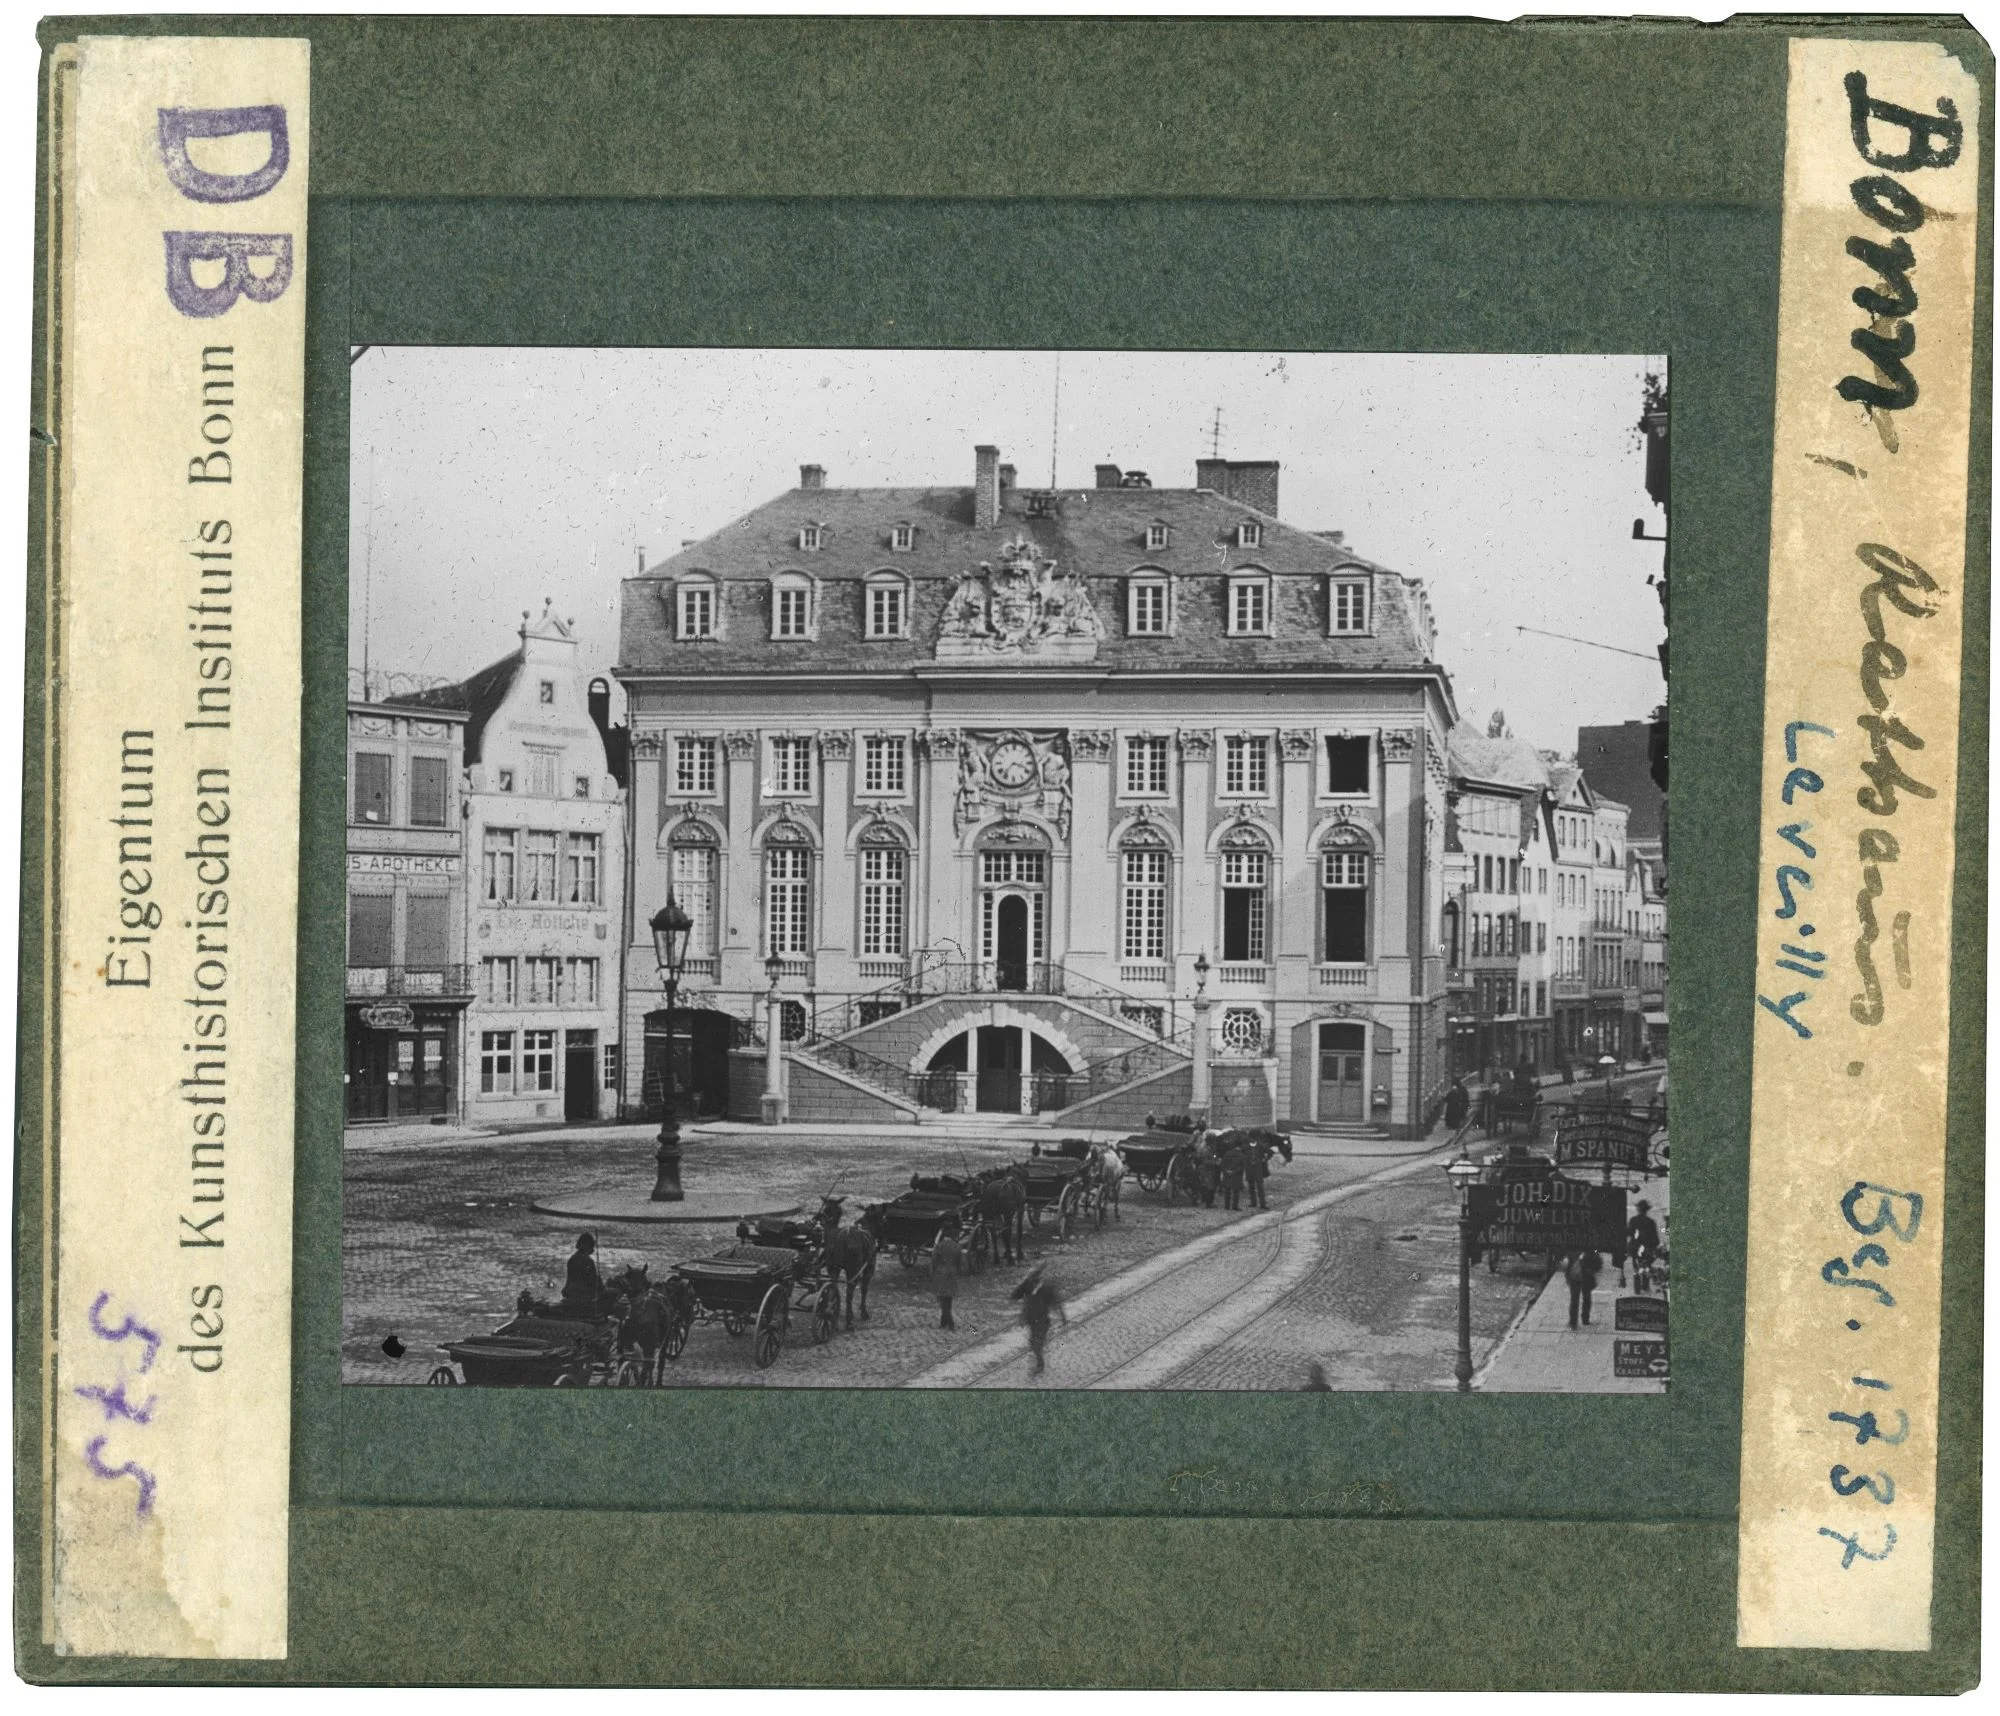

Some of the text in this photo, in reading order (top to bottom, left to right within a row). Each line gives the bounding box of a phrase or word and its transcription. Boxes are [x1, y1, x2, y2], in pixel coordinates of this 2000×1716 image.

[105, 730, 162, 988] Eigentum
[178, 347, 233, 1372] des Kunsthistorischen Instituts Bonn
[1497, 1207, 1592, 1225] JUWELIER
[1552, 1180, 1593, 1207] DIX
[75, 1290, 161, 1515] 575
[1816, 1374, 1910, 1571] 1737
